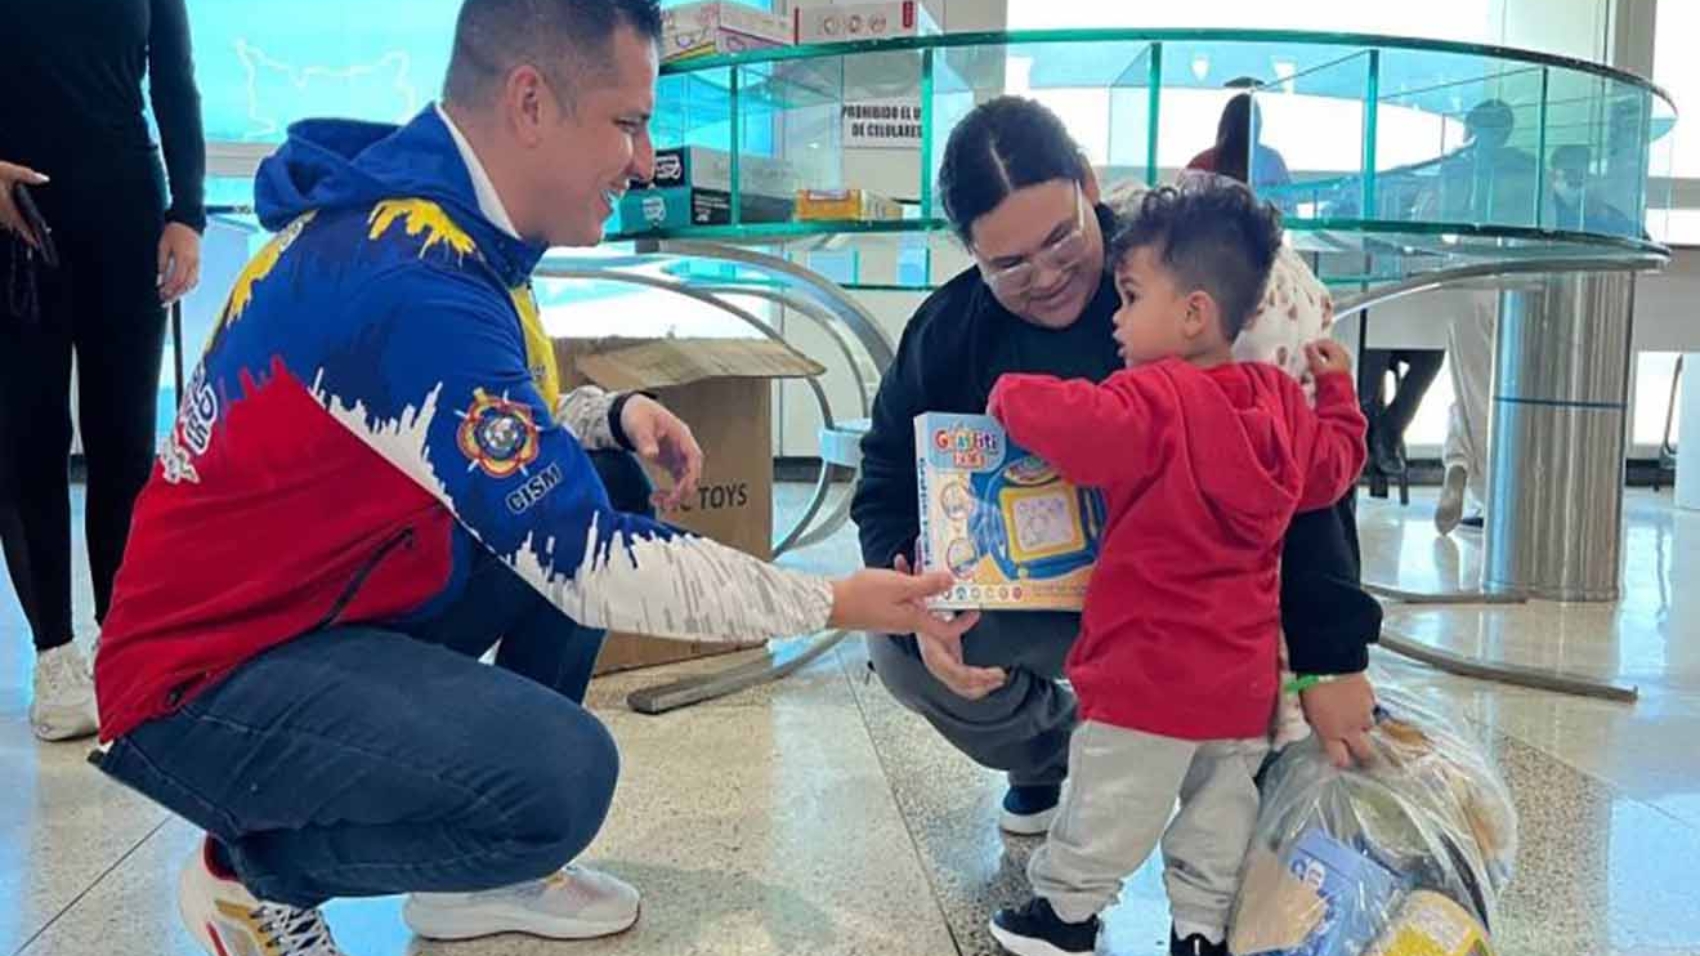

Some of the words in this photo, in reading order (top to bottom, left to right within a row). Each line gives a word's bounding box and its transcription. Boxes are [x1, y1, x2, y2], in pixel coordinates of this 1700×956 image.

[841, 106, 898, 119] PROHIBIDO
[900, 105, 910, 119] EL
[852, 123, 865, 137] DE
[867, 124, 923, 138] CELULARES
[506, 463, 561, 513] CISM
[697, 483, 747, 510] TOYS
